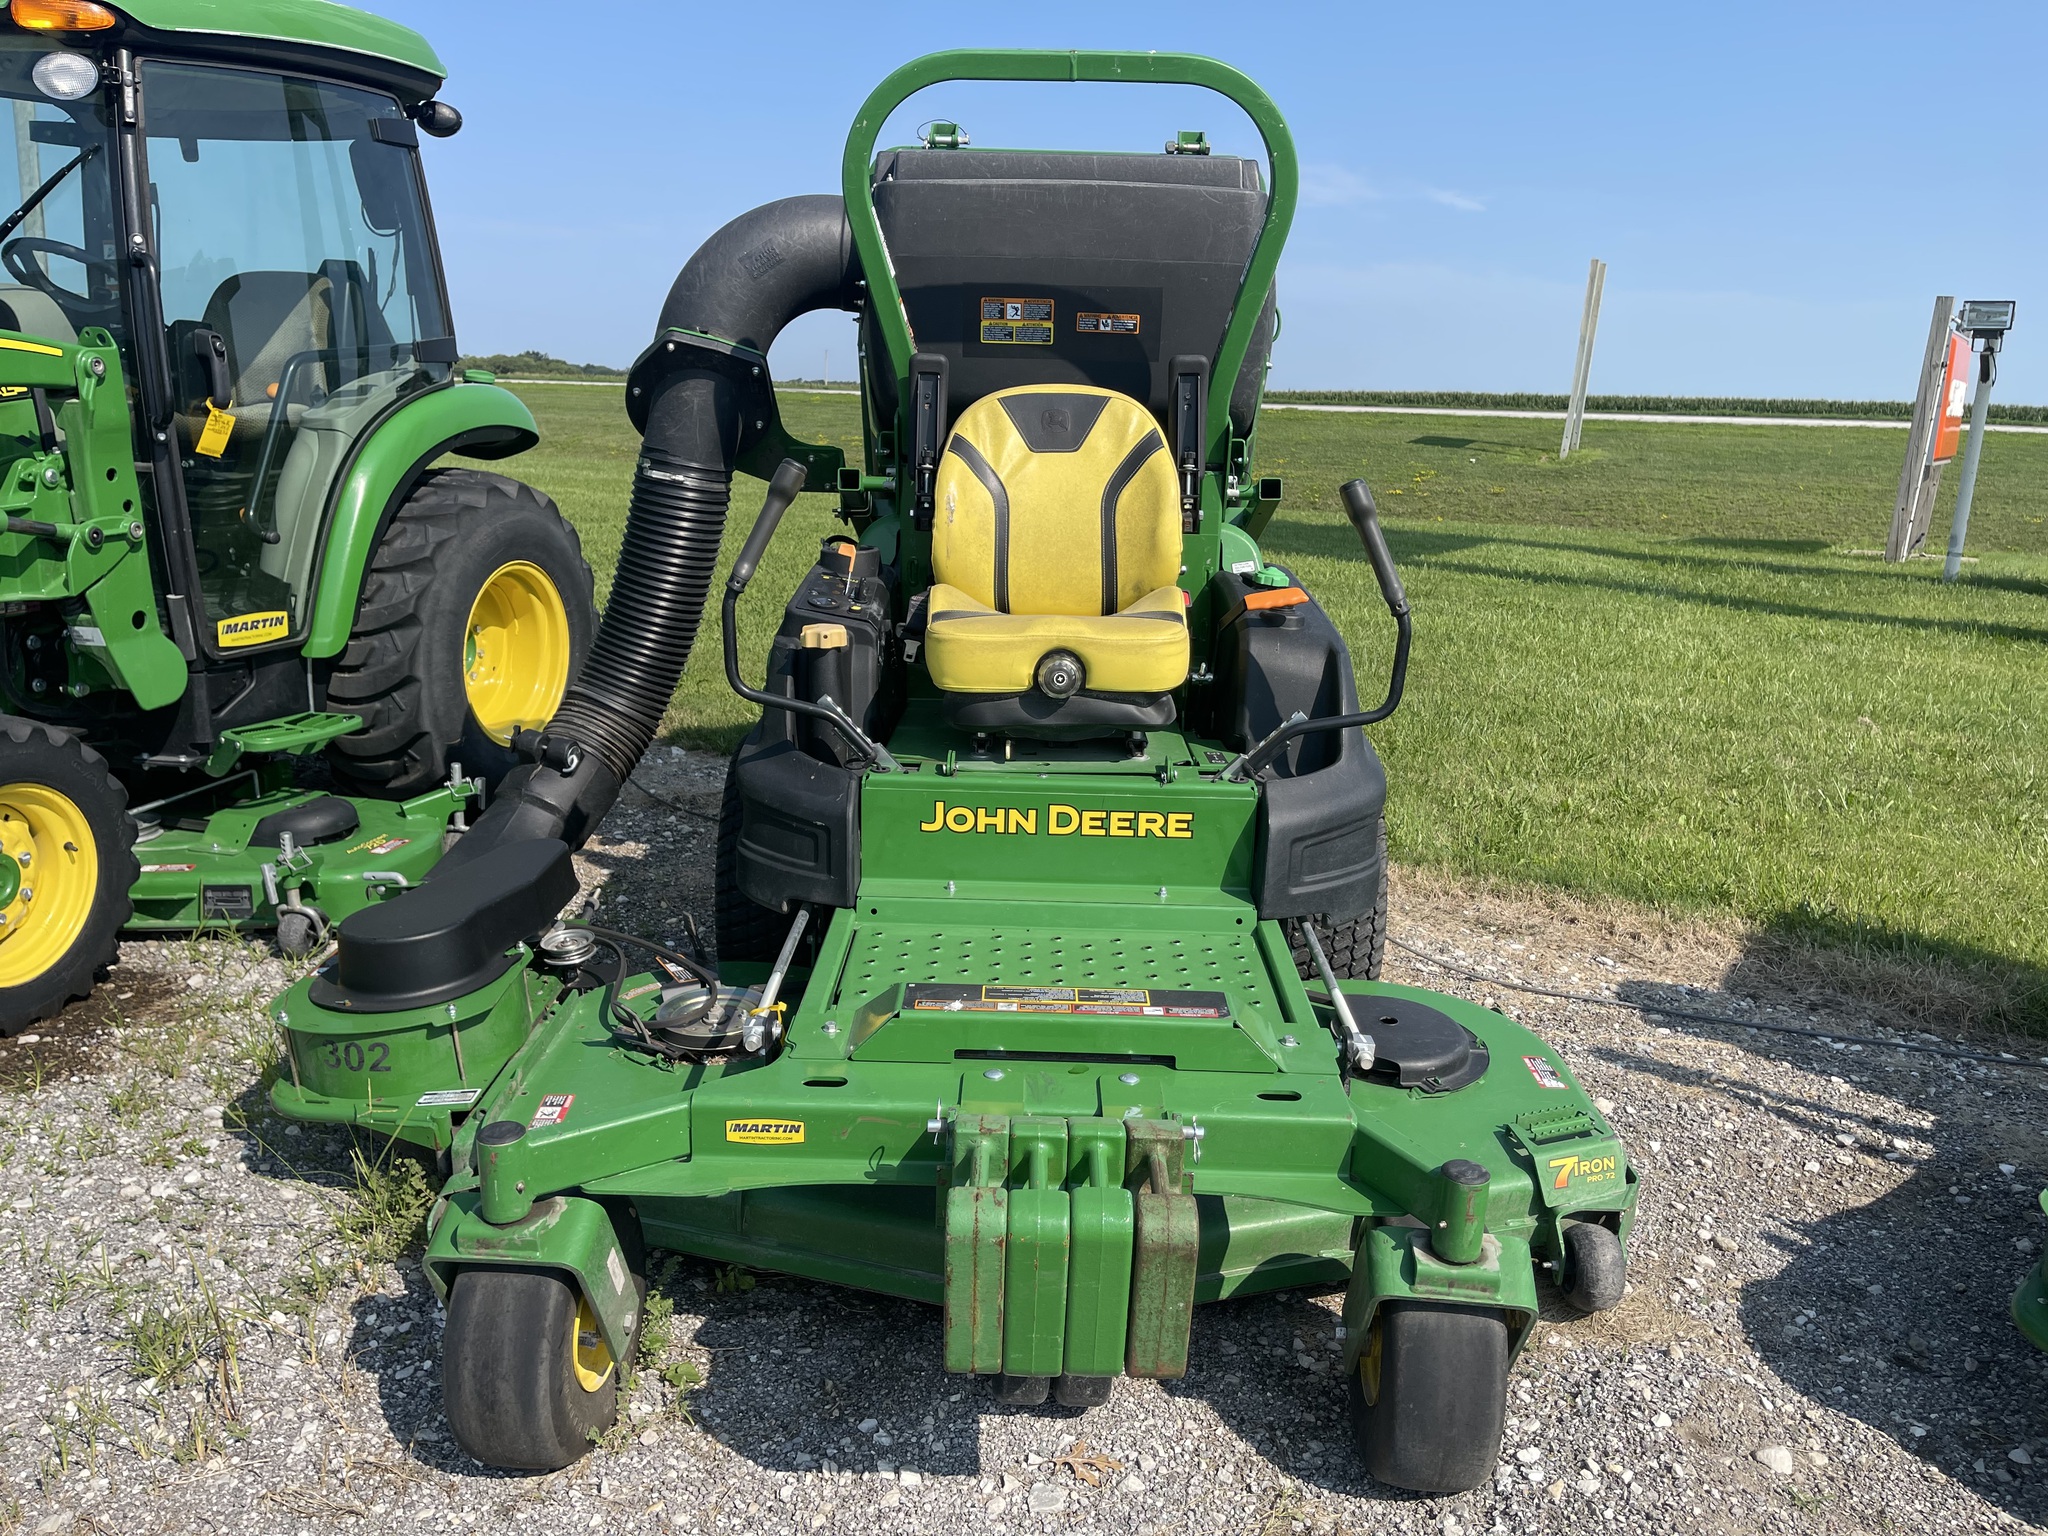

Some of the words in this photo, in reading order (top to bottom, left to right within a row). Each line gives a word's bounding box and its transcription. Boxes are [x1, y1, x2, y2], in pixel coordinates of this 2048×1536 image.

[222, 615, 284, 635] MARTIN
[919, 800, 1038, 836] JOHN
[1047, 803, 1195, 840] DEERE
[321, 1039, 392, 1072] 302
[729, 1123, 802, 1133] MARTIN
[1586, 1174, 1604, 1183] PRO
[1605, 1172, 1616, 1180] 72
